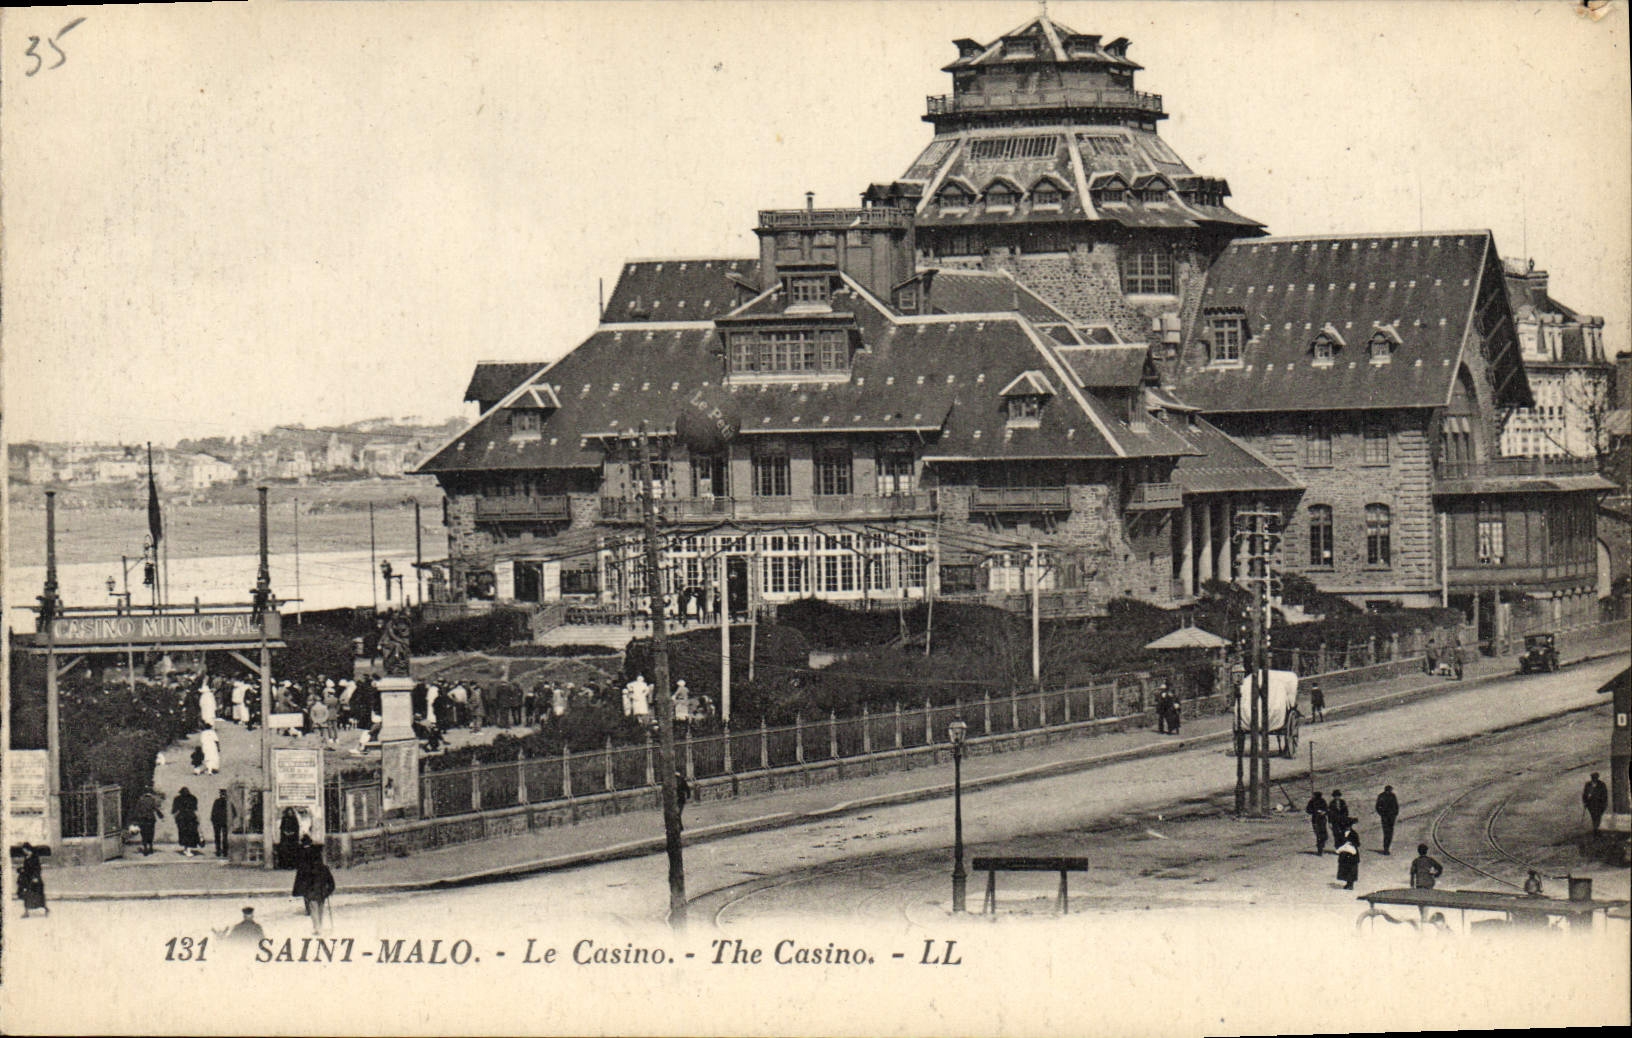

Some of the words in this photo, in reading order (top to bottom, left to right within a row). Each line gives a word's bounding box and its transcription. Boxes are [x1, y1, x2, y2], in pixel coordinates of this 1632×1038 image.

[25, 16, 88, 77] 35
[54, 617, 134, 639] CASINO
[141, 614, 261, 637] MUNICIPAL
